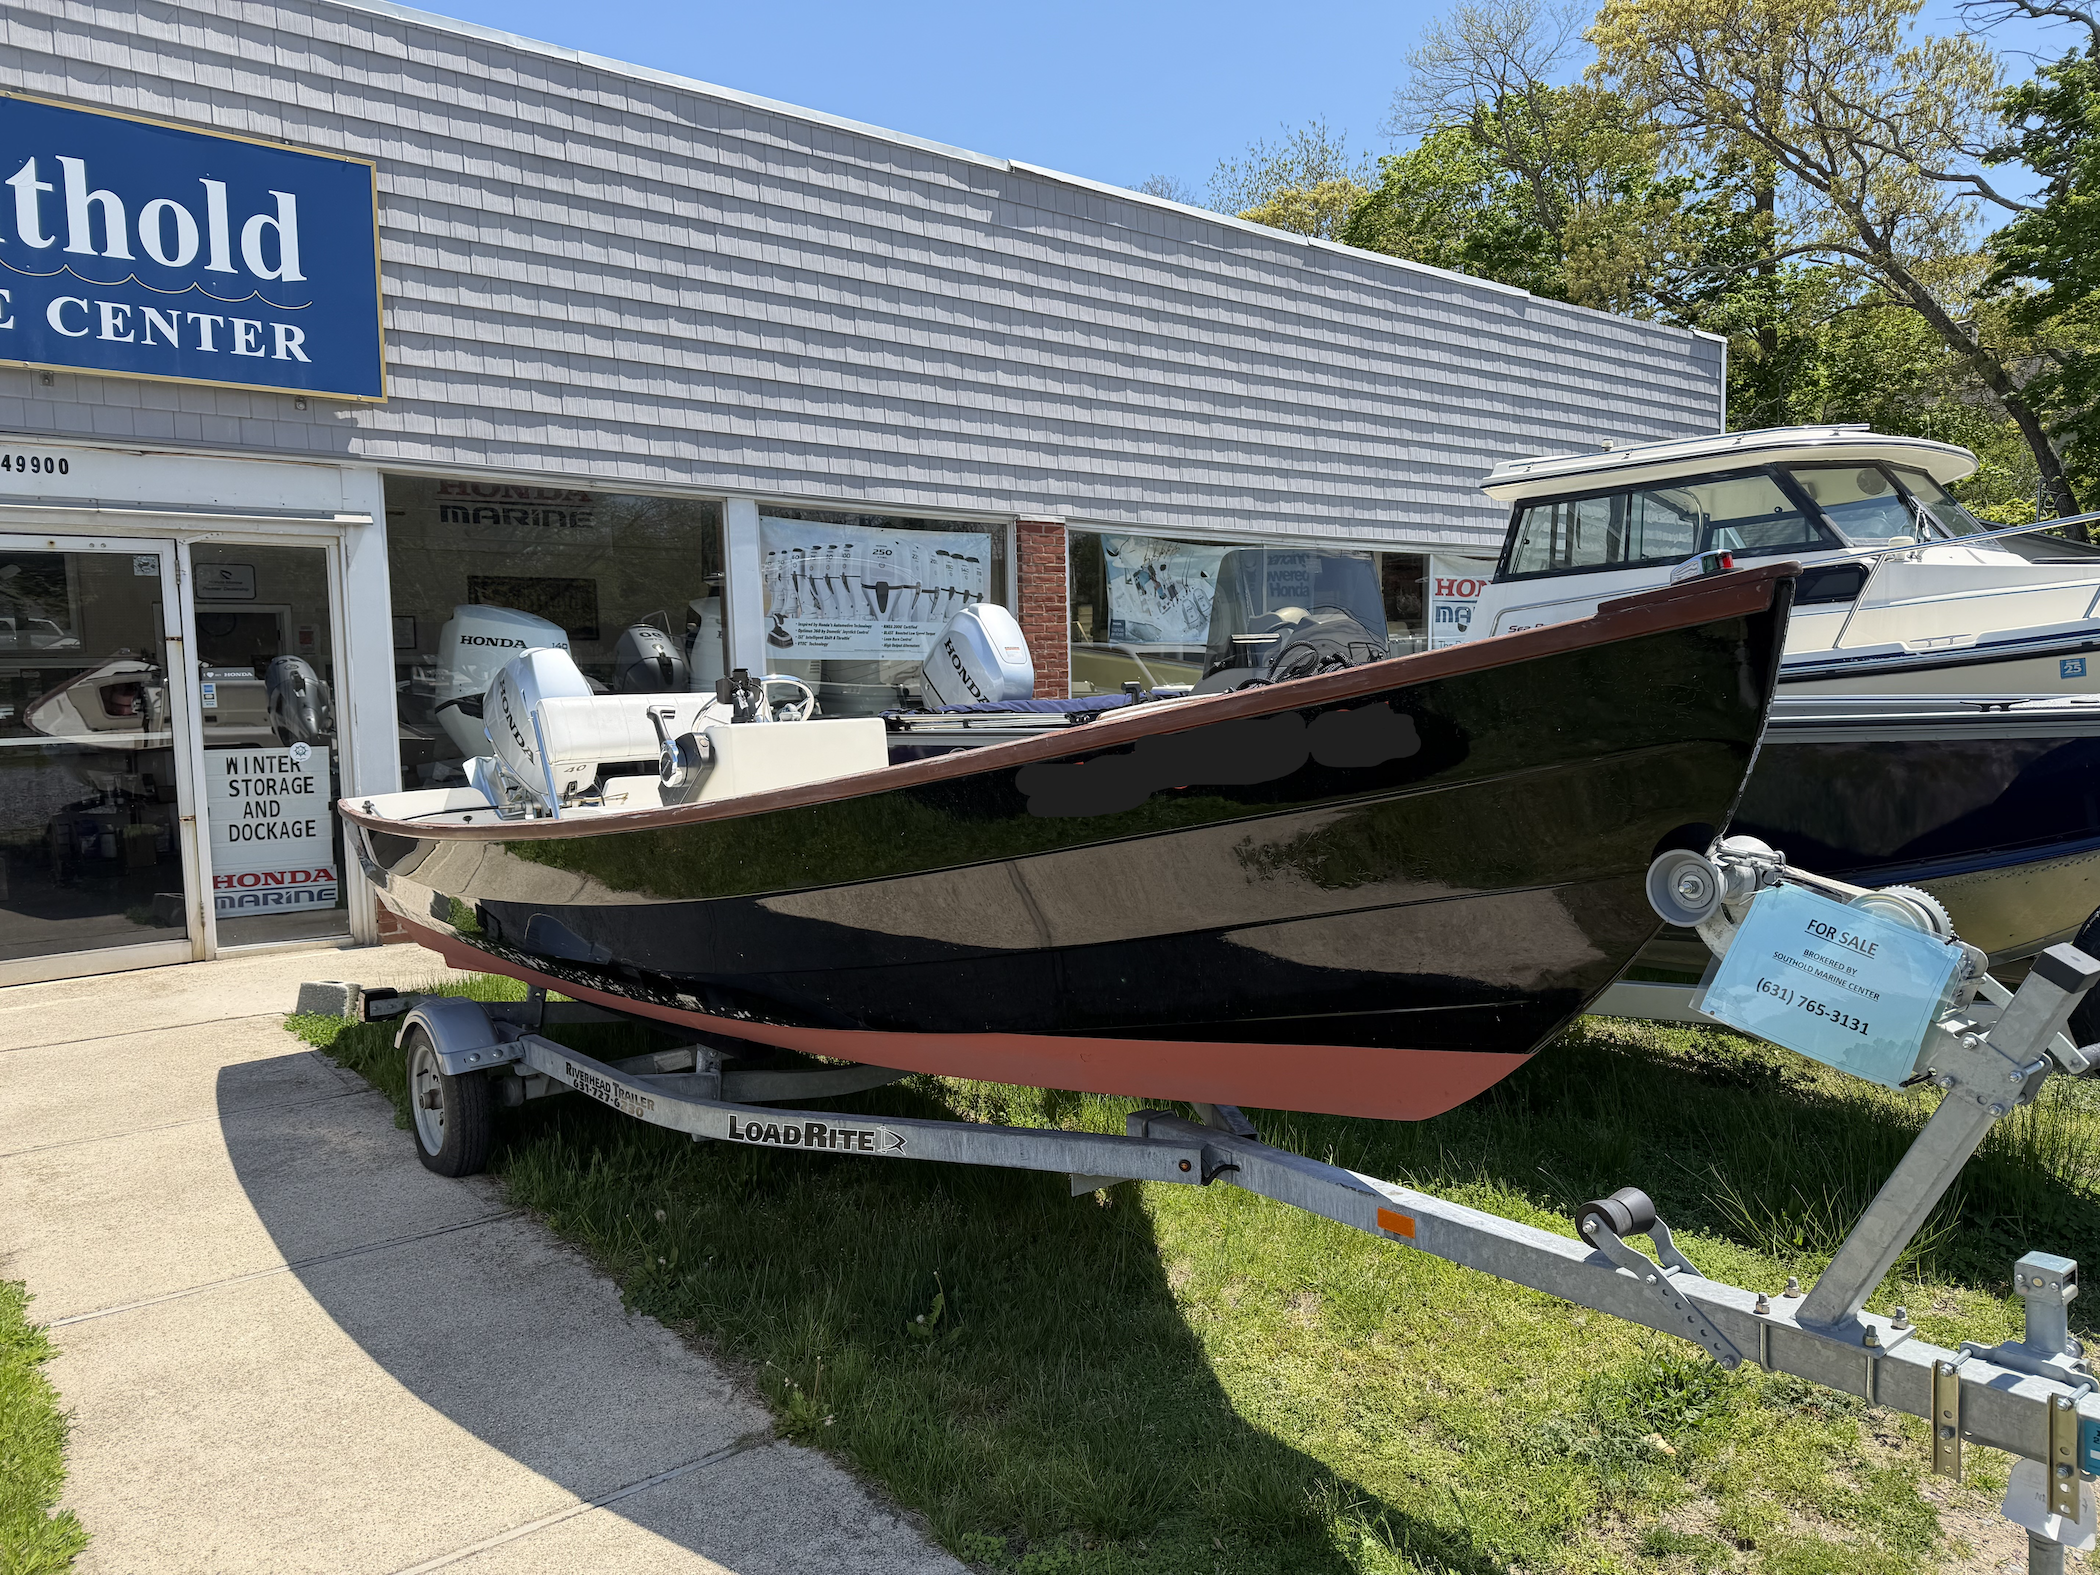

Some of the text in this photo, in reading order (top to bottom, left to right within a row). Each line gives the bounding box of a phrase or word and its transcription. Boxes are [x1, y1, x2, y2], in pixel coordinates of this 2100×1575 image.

[0, 155, 308, 282] thold
[46, 296, 312, 362] CENTER
[1, 454, 69, 475] 49900
[440, 505, 593, 529] MARINE
[1269, 582, 1310, 597] Honda
[460, 635, 528, 649] HONDA
[552, 642, 568, 650] 140
[2063, 664, 2082, 674] 25
[500, 679, 535, 765] HONDA
[226, 755, 301, 775] WINTER
[564, 764, 587, 773] 40
[229, 776, 315, 797] STORAGE
[243, 800, 281, 819] AND
[229, 820, 316, 842] DOCKAGE
[212, 868, 337, 889] HONDA
[214, 888, 337, 909] MARINE
[1807, 919, 1879, 956] FOR SALE
[1803, 949, 1858, 976] BROKERED BY
[1773, 951, 1880, 1000] SOUTHOLD MARINE CENTER
[1756, 977, 1870, 1036] (631) 765-3131
[566, 1061, 655, 1111] RIVERHEAD TRAILER
[573, 1079, 644, 1118] 631-727-6230
